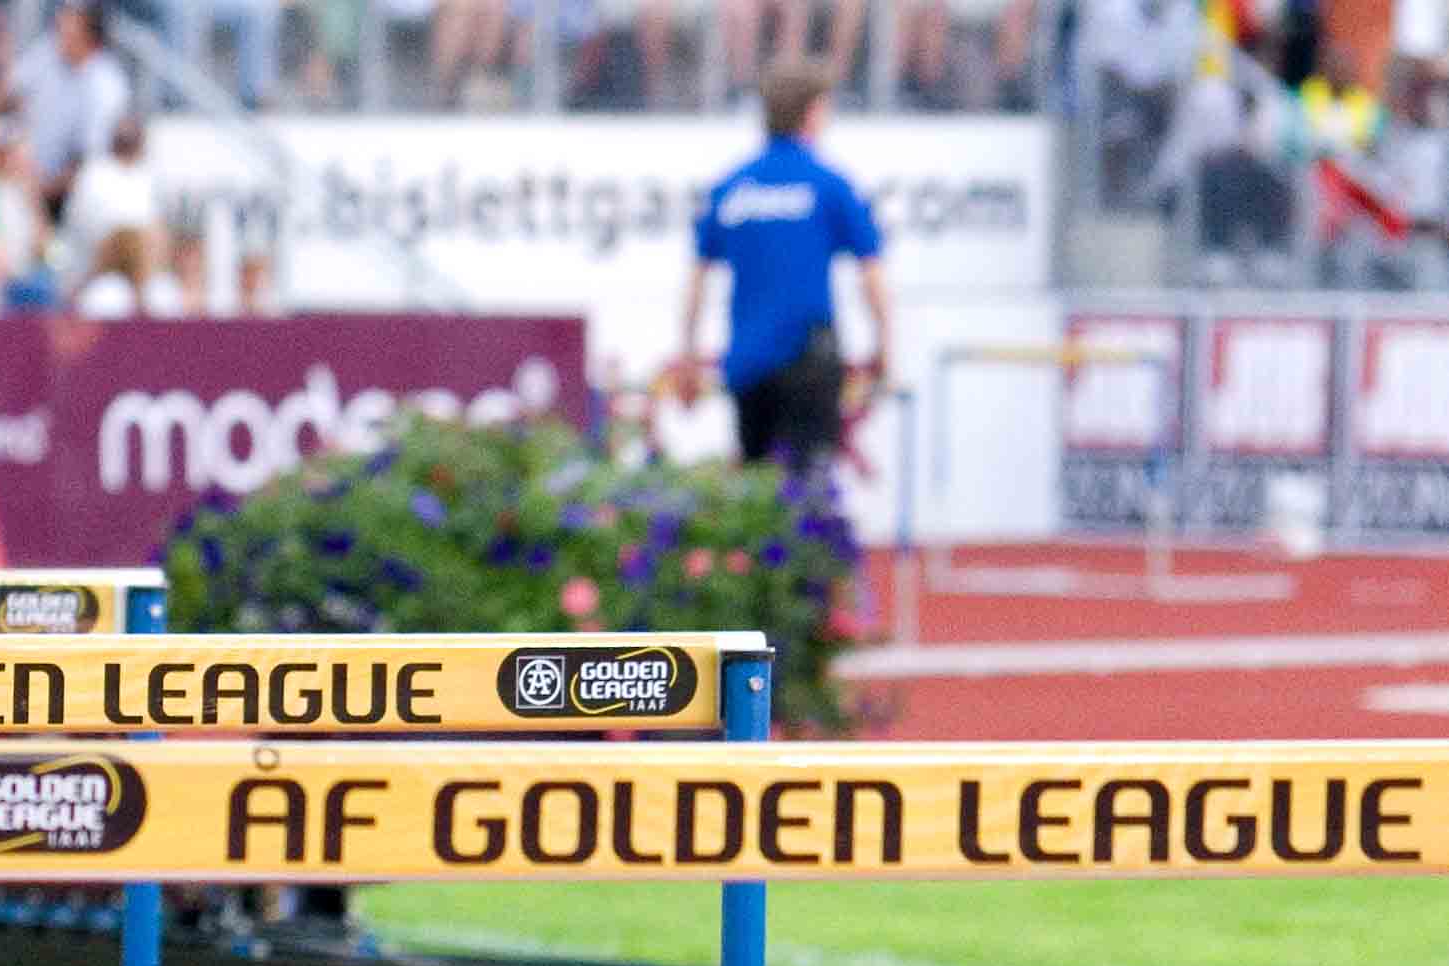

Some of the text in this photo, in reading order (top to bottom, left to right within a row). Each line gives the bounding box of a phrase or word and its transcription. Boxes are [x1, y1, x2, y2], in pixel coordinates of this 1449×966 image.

[580, 660, 668, 681] GOLDEN
[103, 661, 443, 726] LEAGUE
[579, 680, 668, 700] LEAGUE
[628, 699, 668, 712] IAAF
[225, 744, 1424, 866] ÅF GOLDEN LEAGUE
